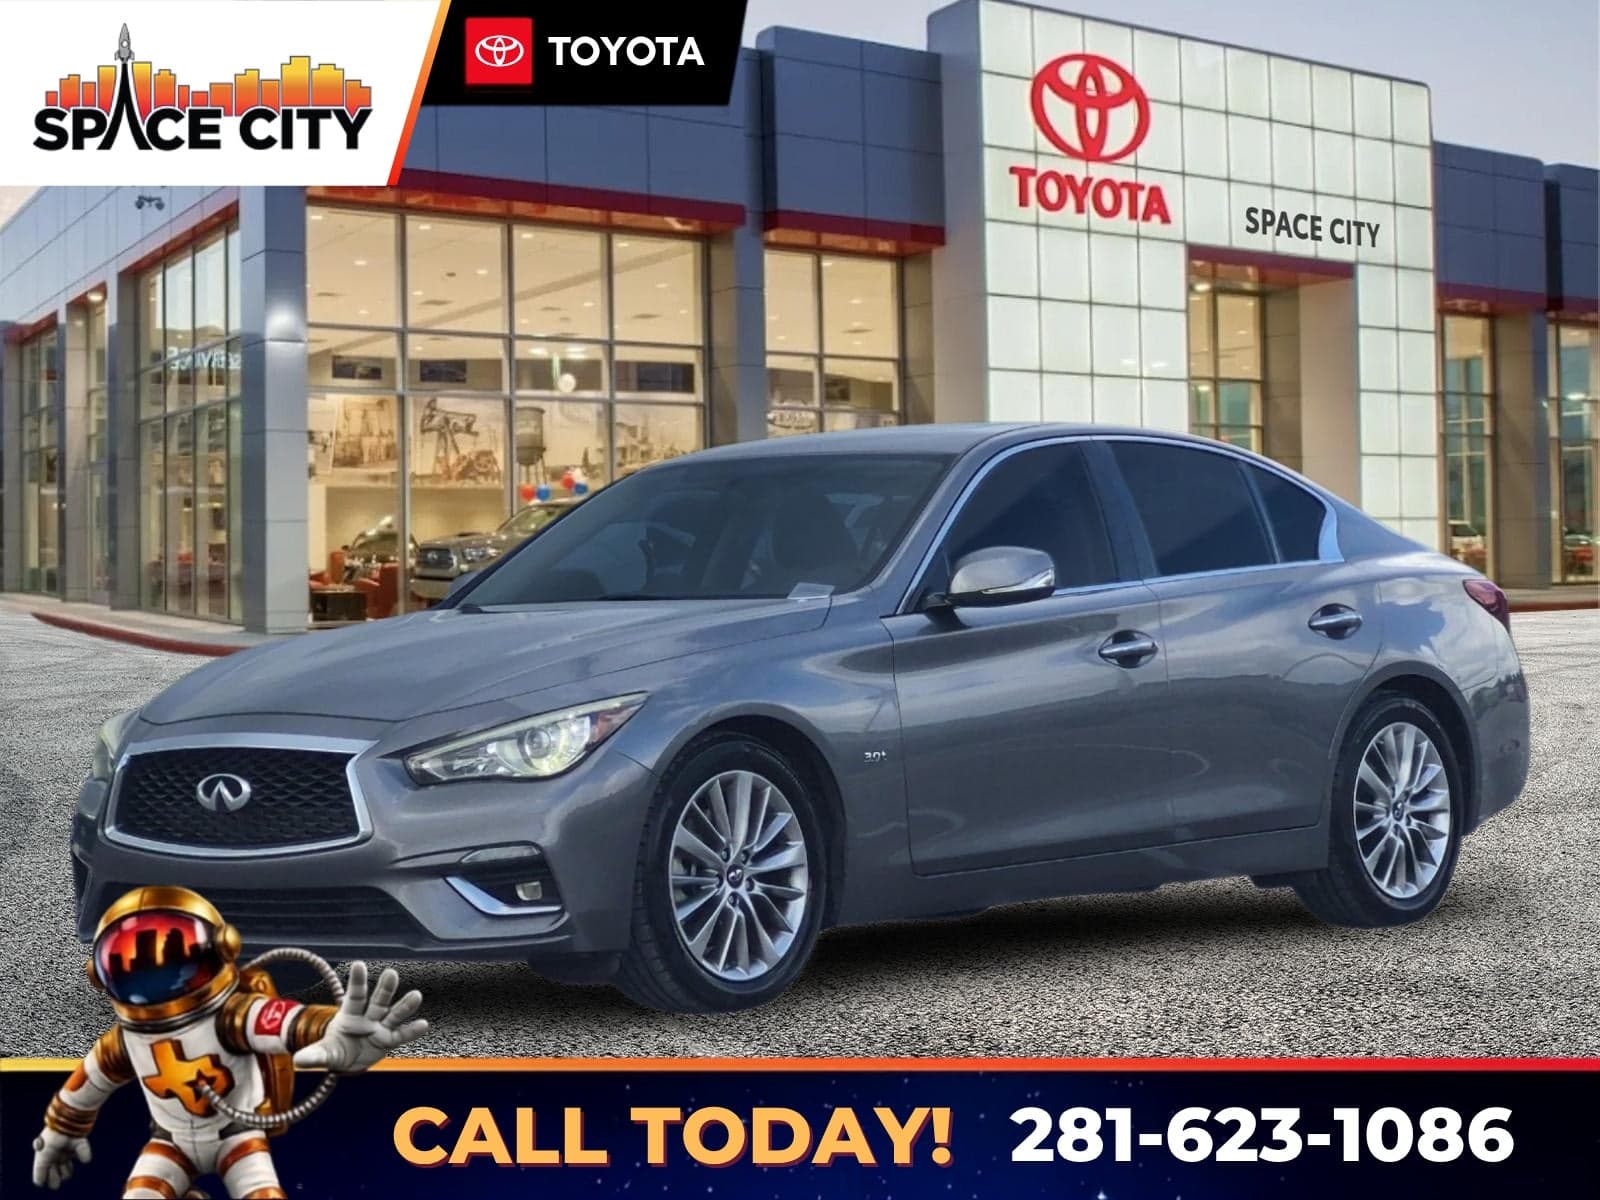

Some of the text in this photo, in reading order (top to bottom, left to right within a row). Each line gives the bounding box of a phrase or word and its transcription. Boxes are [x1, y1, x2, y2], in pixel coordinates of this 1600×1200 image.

[1009, 166, 1171, 224] TOYOTA
[1245, 207, 1380, 248] SPACE CITY
